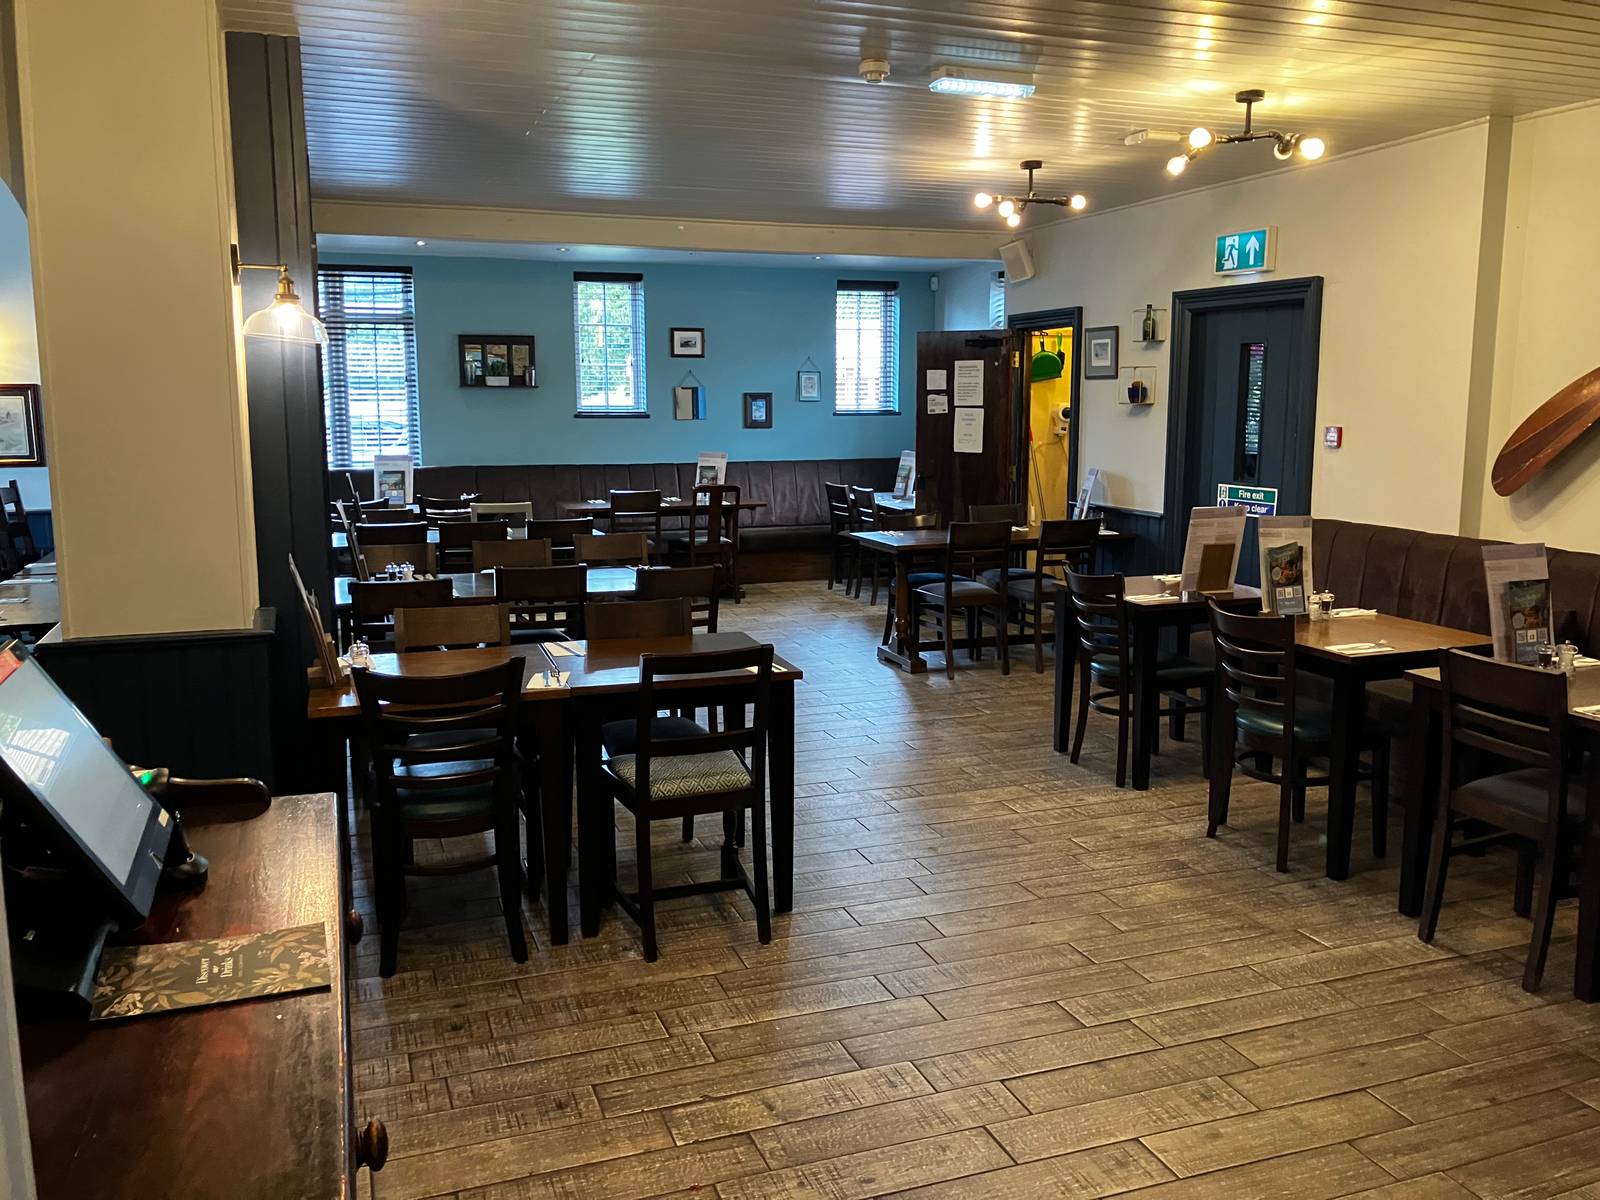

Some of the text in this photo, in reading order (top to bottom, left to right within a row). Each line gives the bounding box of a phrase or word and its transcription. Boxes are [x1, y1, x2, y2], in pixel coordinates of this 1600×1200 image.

[1238, 490, 1264, 500] Fire exit
[1251, 504, 1268, 514] clear
